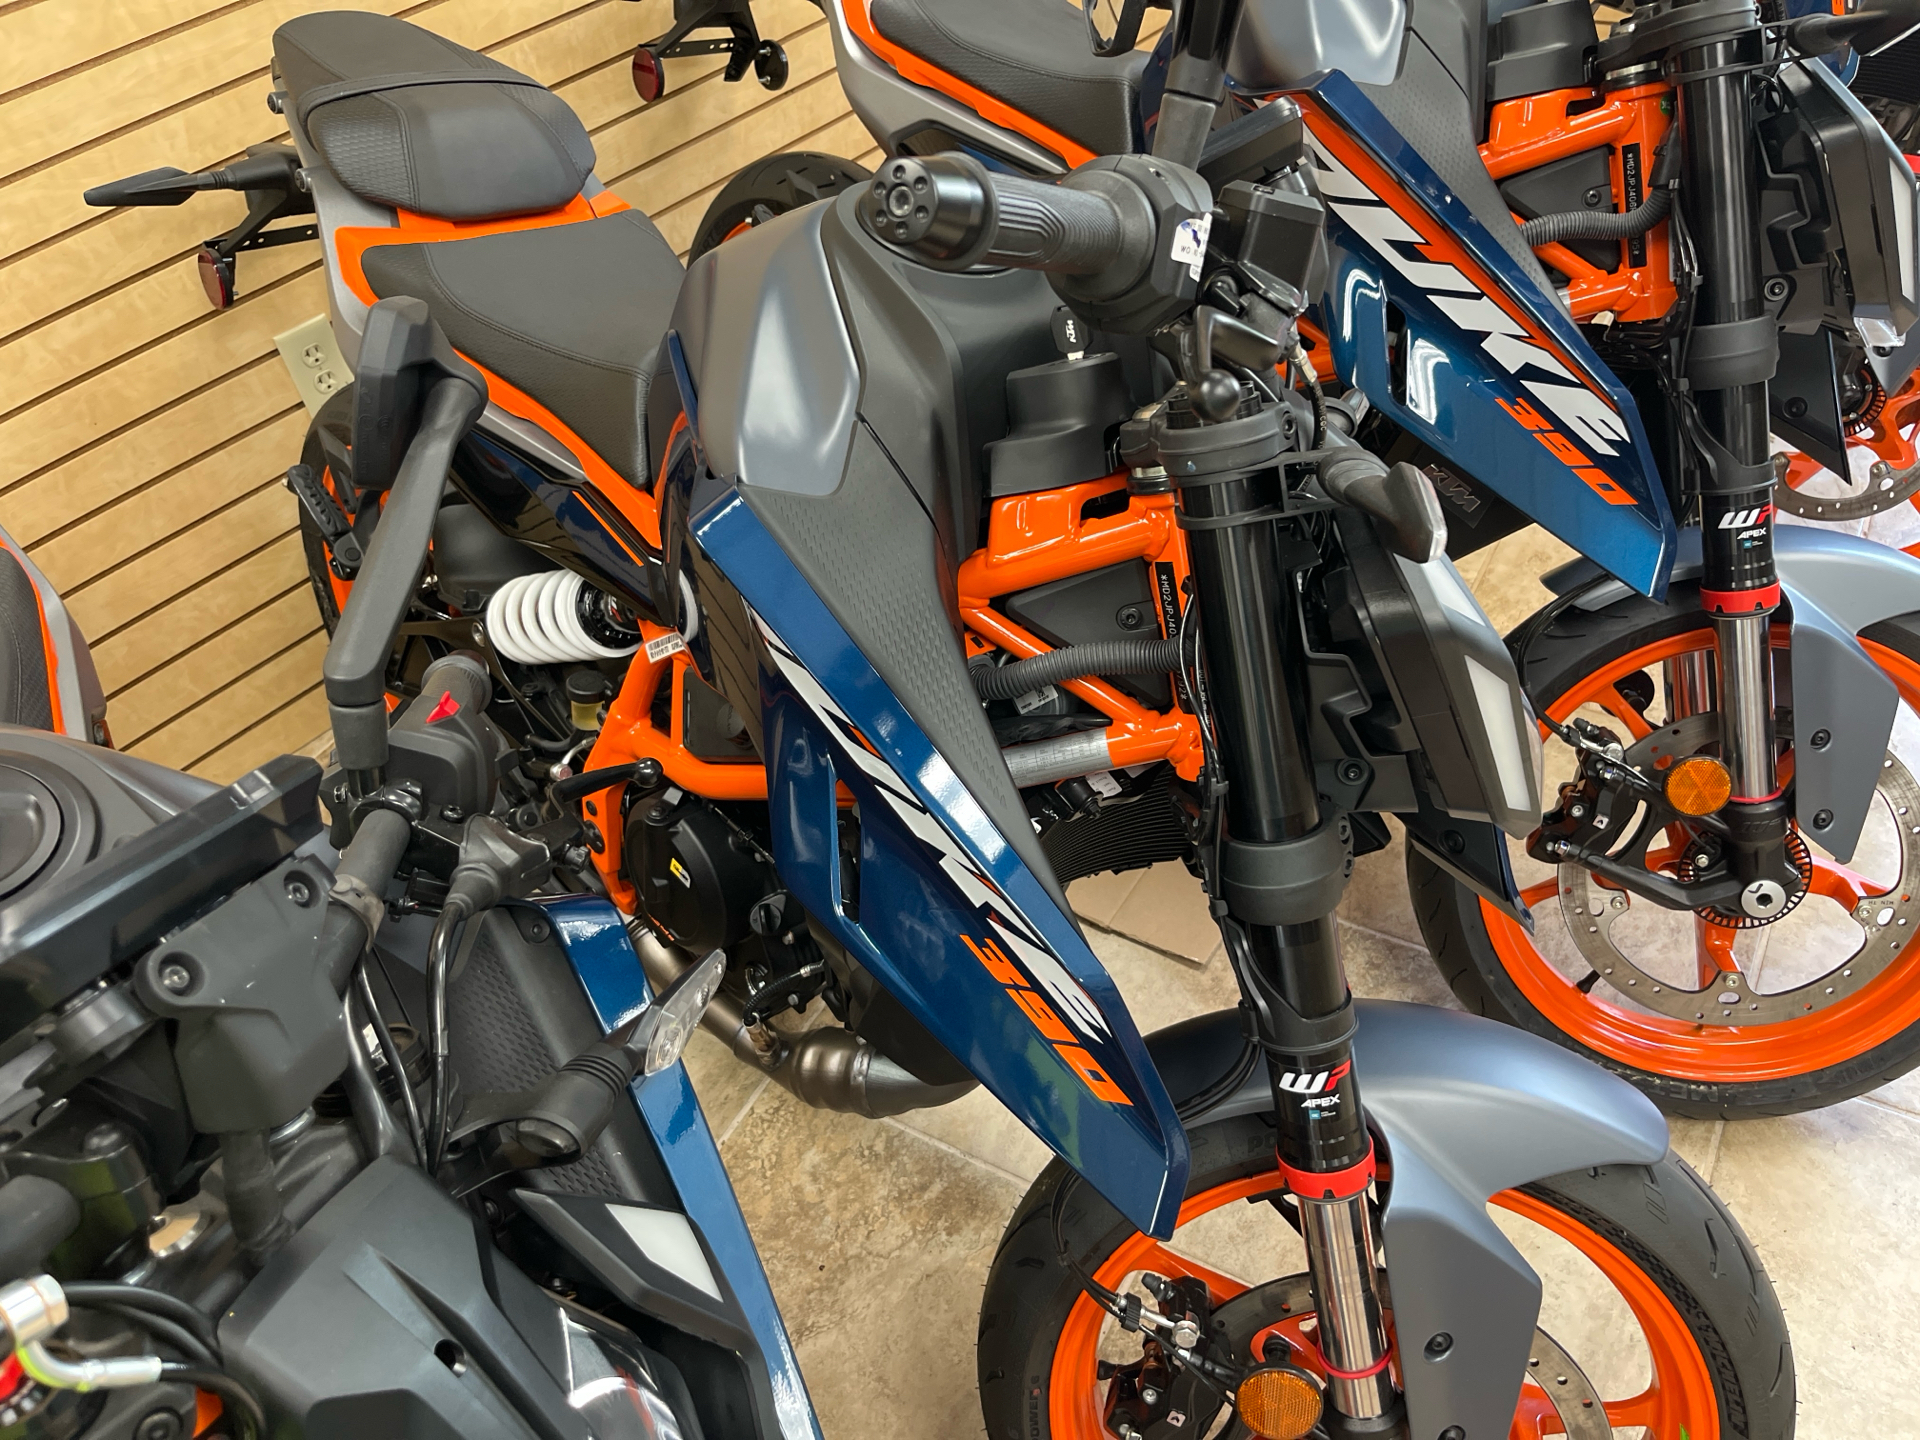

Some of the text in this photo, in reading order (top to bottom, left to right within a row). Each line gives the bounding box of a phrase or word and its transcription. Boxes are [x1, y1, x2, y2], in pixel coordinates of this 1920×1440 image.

[1065, 319, 1077, 343] KTM
[1495, 397, 1639, 506] 390
[1424, 463, 1481, 513] KTM
[1718, 504, 1773, 529] WP
[1737, 527, 1767, 540] APEX
[960, 934, 1135, 1107] 390
[1278, 1059, 1351, 1094] WP
[1301, 1093, 1341, 1108] APEX
